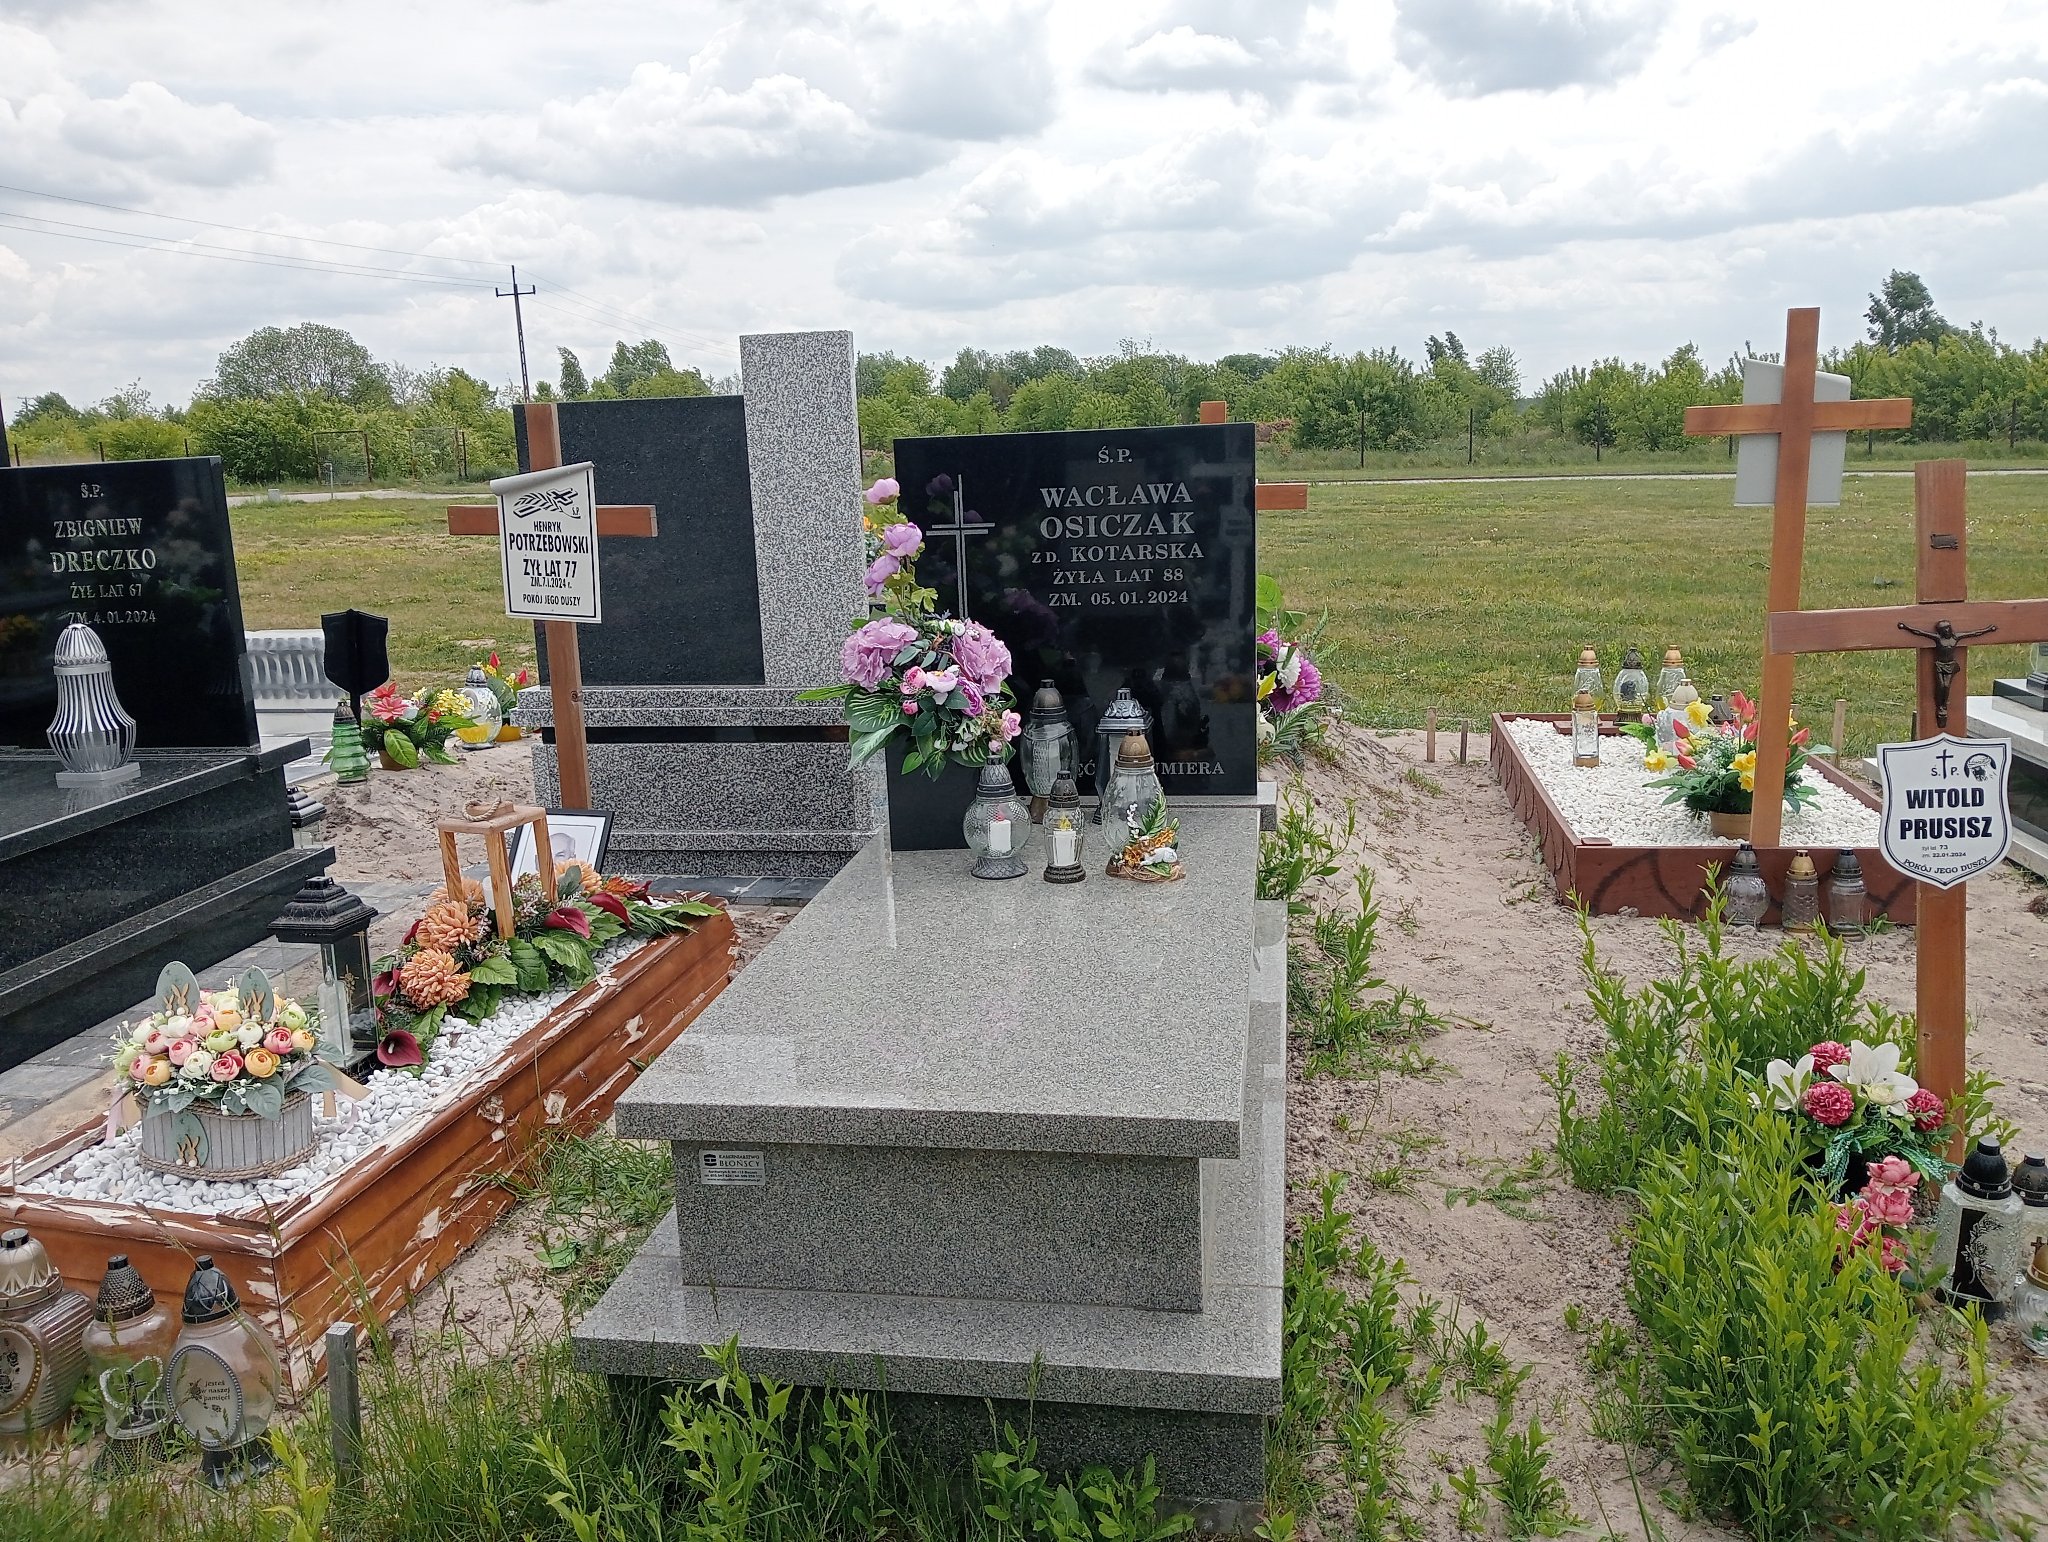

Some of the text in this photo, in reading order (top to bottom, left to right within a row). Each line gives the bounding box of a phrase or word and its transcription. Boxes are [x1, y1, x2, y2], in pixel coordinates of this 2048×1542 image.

[1040, 482, 1193, 508] WACŁAWA
[53, 518, 143, 538] ZBIGNIEW
[533, 520, 562, 533] HENRYK
[1040, 511, 1195, 539] OSICZAK
[509, 532, 589, 554] POTRZEBOWSKI
[1070, 542, 1204, 563] KOTARSKA
[50, 548, 157, 573] DRECZKO
[522, 554, 577, 578] ŻYŁ LAT 77
[1053, 568, 1184, 585] ŻYŁA LAT 88
[70, 581, 142, 599] ŻYŁ LAT 67
[522, 592, 581, 607] POKÓJ JEGO DUSZY
[1049, 592, 1082, 607] ZM.
[1906, 787, 1985, 809] WITOLD
[1900, 816, 1993, 840] PRUSISZ
[1903, 856, 1988, 874] POKÓJ JEGO DUSZY
[205, 1380, 226, 1388] jesteś
[203, 1393, 231, 1402] pamięci
